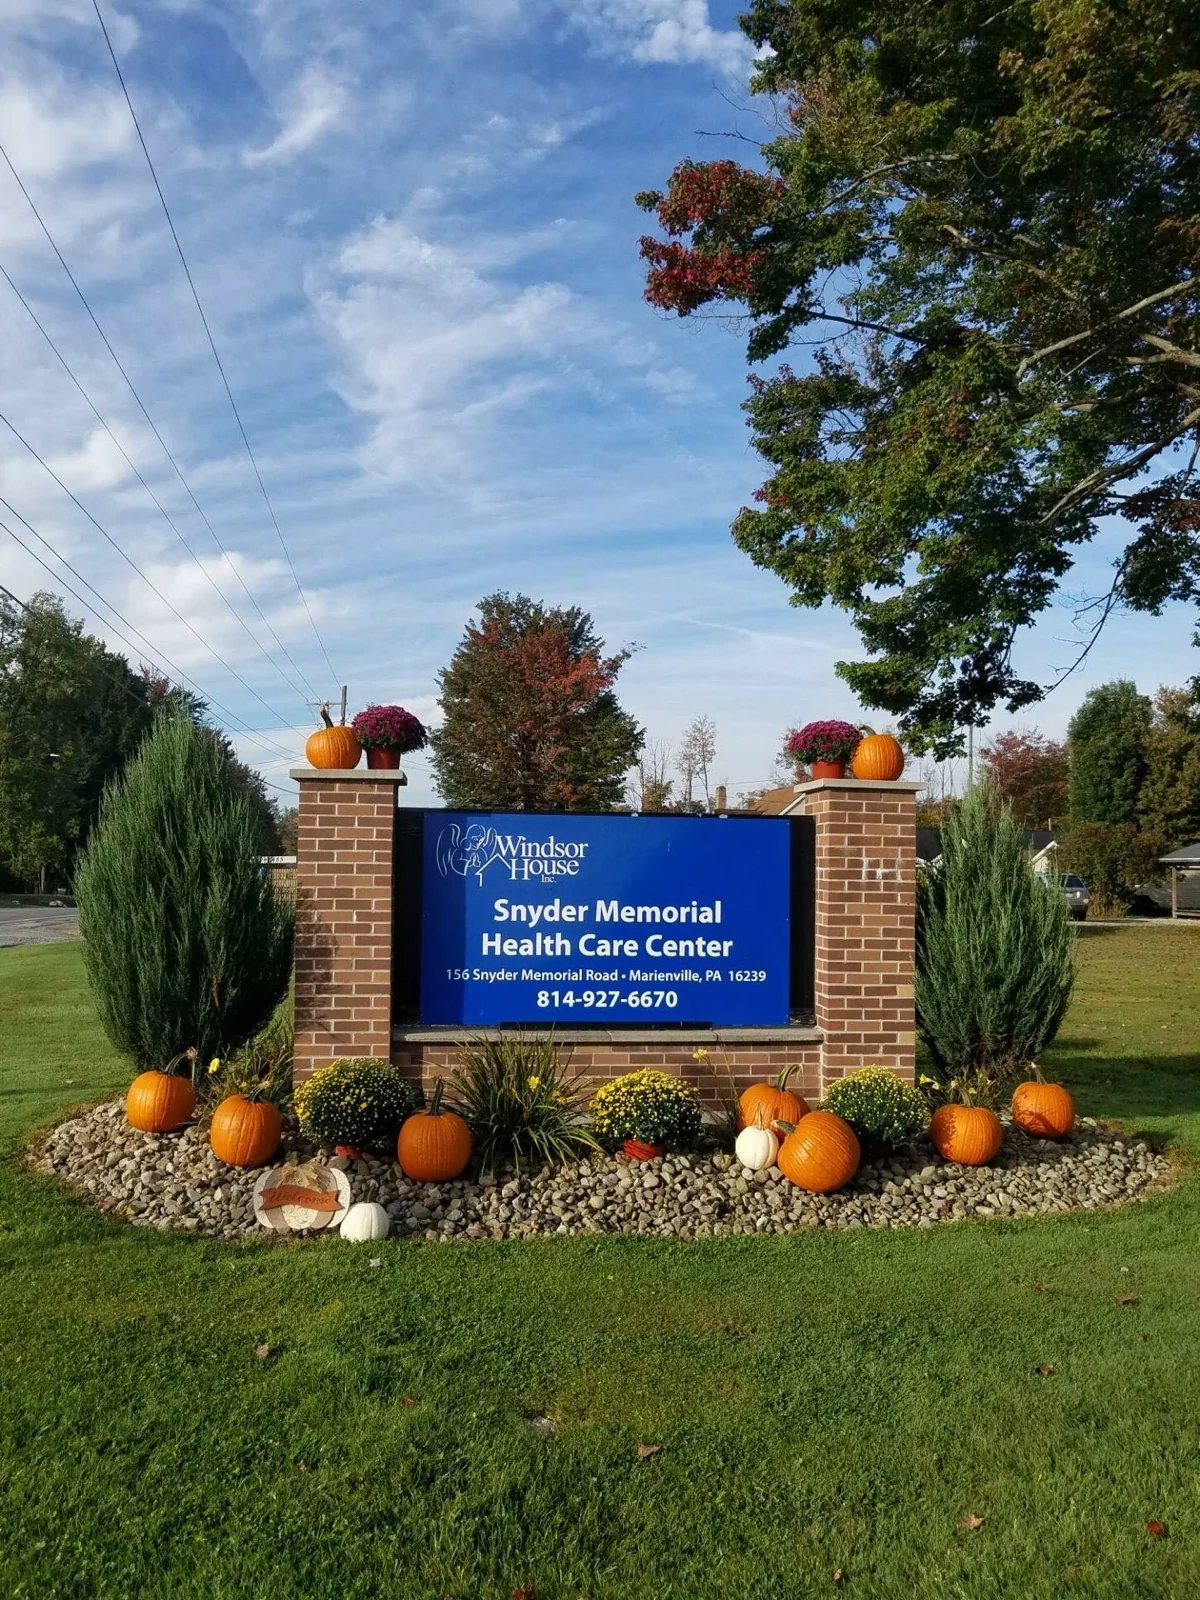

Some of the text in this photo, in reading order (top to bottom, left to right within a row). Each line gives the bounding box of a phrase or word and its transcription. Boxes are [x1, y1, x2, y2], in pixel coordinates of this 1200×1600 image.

[495, 835, 589, 859] Windsor
[509, 858, 580, 881] House
[541, 874, 557, 883] Inc.
[493, 898, 722, 928] Snyder Memorial
[482, 932, 734, 957] Health Care Center
[446, 968, 767, 984] 156 Snyder Memorial Road Marienville, PA 16239
[536, 990, 678, 1008] 814-927-6670
